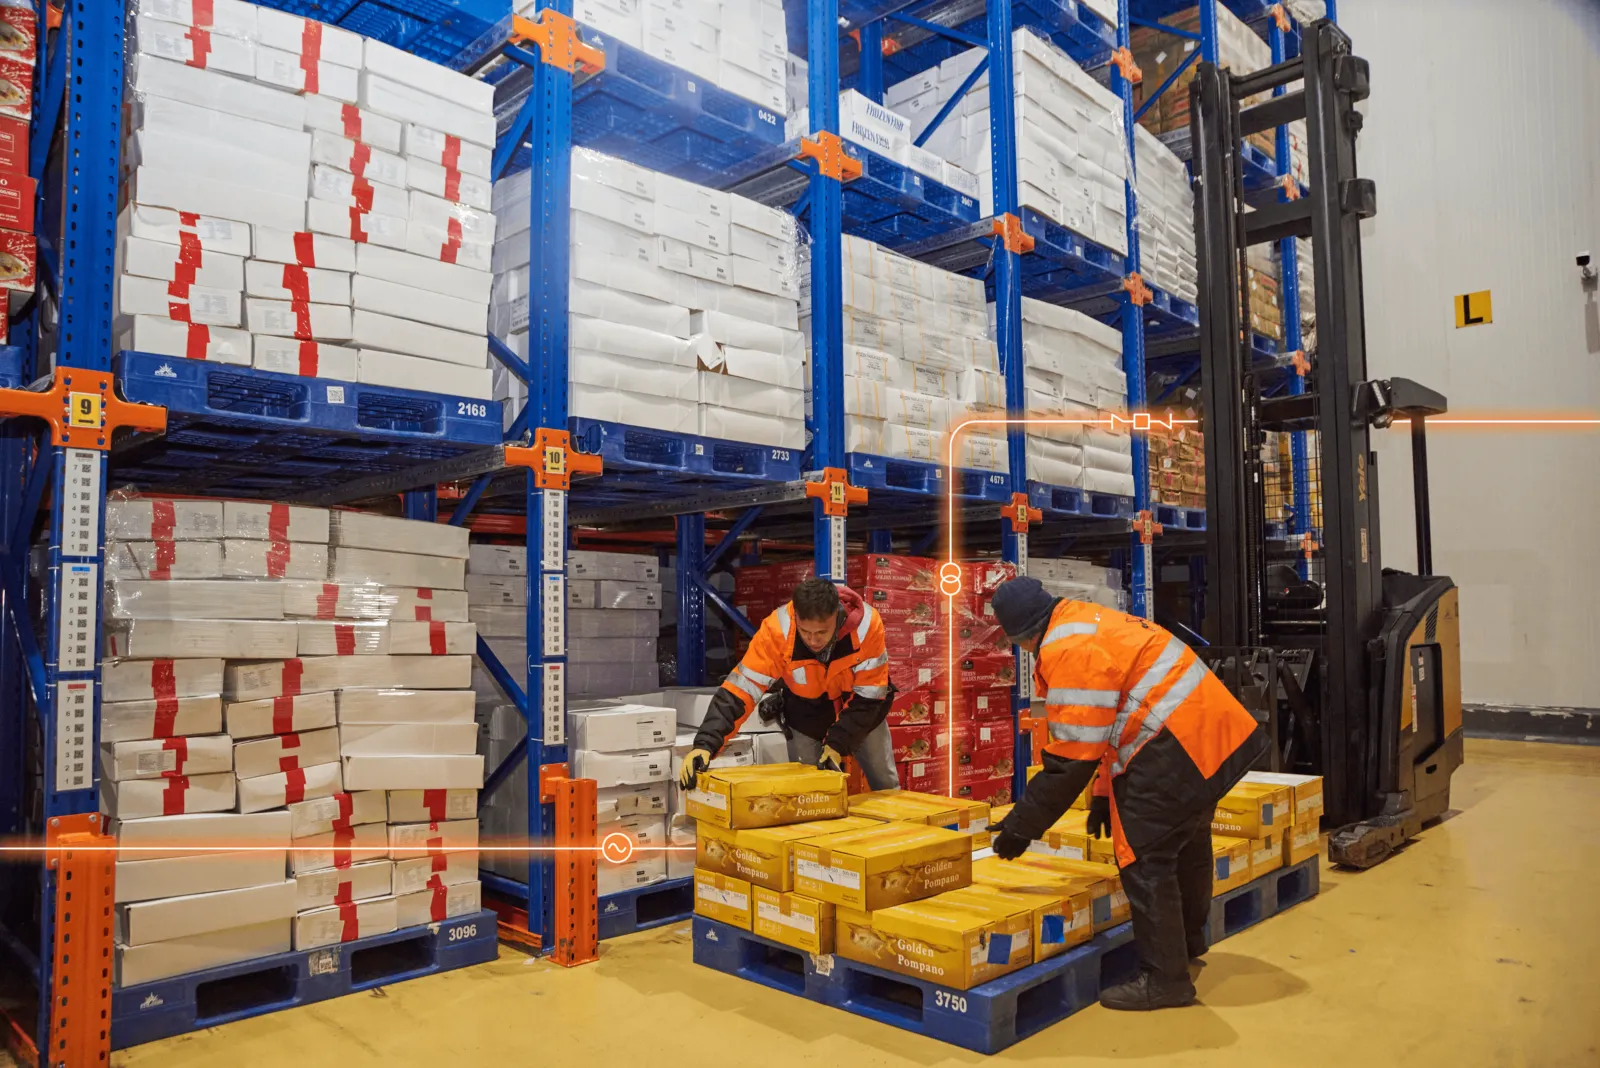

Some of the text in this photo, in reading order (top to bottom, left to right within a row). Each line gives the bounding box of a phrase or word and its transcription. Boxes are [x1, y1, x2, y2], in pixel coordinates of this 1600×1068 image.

[758, 109, 776, 126] 0422
[1463, 294, 1483, 324] L
[80, 399, 91, 415] 9
[458, 402, 486, 417] 2168
[549, 452, 560, 464] 10
[772, 450, 789, 461] 2733
[834, 486, 840, 495] 11
[798, 794, 829, 804] Golden
[795, 807, 837, 817] Pompano
[1216, 809, 1232, 819] den
[1211, 822, 1241, 831] mpano
[736, 850, 762, 864] Golden
[736, 863, 768, 880] Pompano
[924, 861, 952, 875] Golden
[924, 873, 959, 889] Pompano
[449, 924, 477, 941] 3096
[897, 939, 934, 957] Golden
[898, 954, 944, 976] Pompano
[935, 990, 967, 1013] 3750
